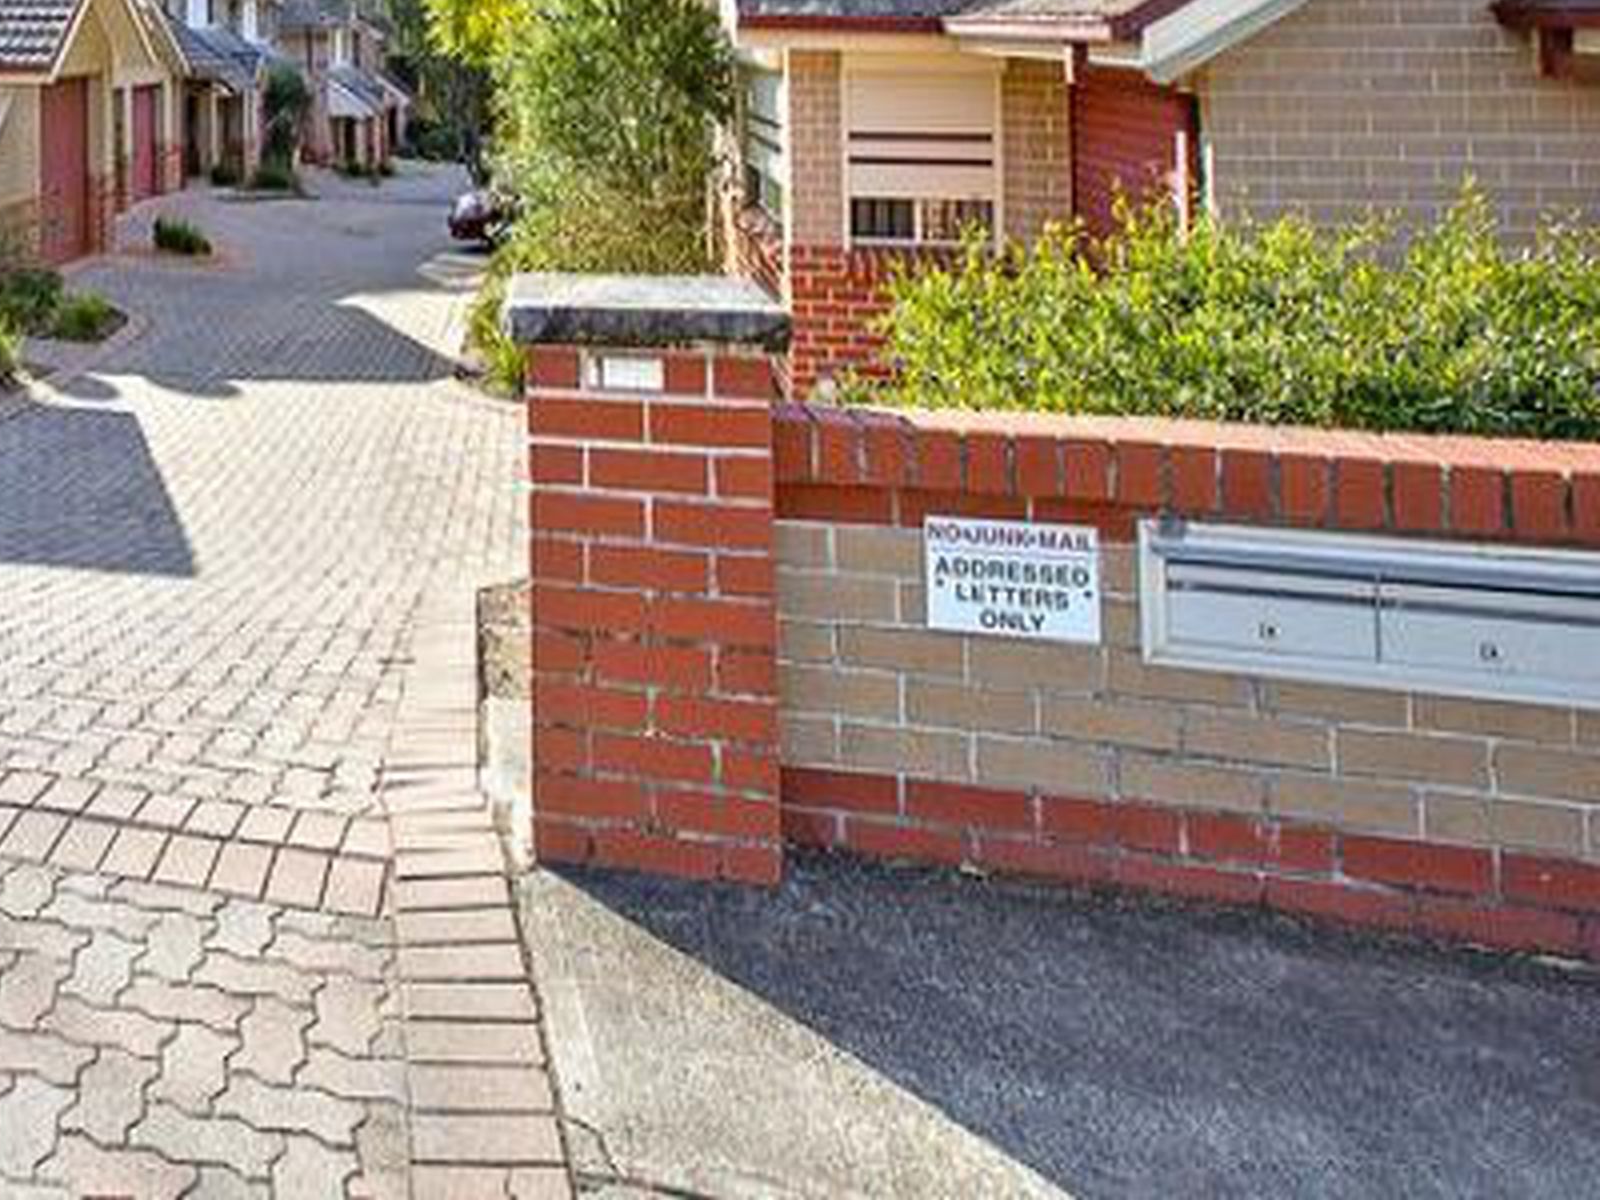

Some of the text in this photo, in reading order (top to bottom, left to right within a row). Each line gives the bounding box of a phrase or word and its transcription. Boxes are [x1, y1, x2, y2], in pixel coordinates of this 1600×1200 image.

[935, 556, 1090, 588] ADDRESSED
[955, 583, 1070, 611] LETTERS
[979, 609, 1045, 633] ONLY
